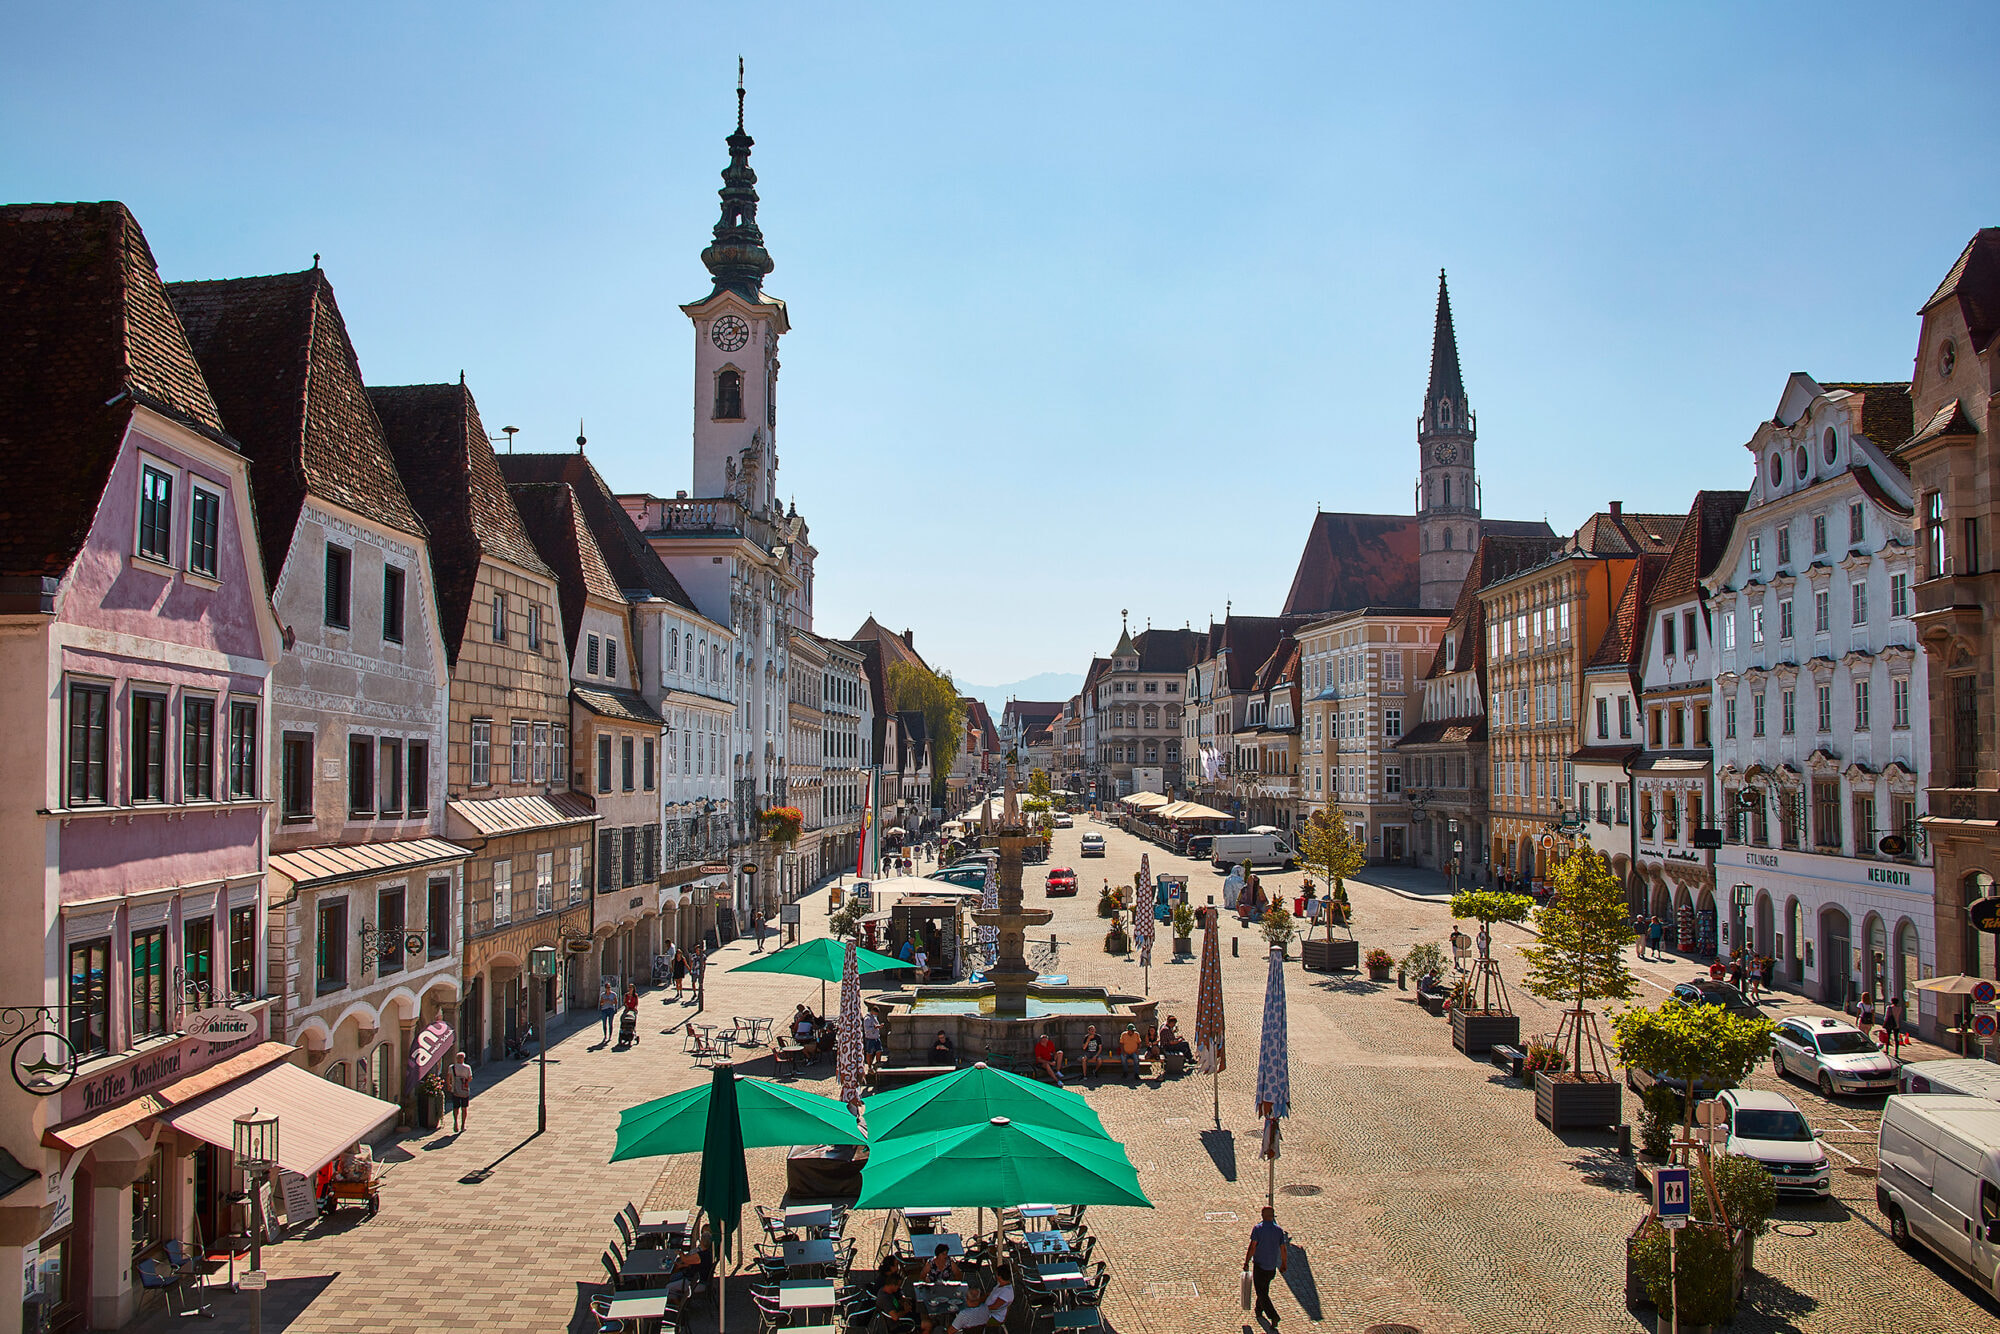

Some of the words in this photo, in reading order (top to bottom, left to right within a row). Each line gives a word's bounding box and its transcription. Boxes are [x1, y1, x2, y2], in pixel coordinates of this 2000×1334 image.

[701, 865, 729, 873] Oberbank
[1868, 867, 1911, 886] NEUROTH
[83, 1074, 126, 1111] Kaffee
[130, 1048, 181, 1092] Konditorei
